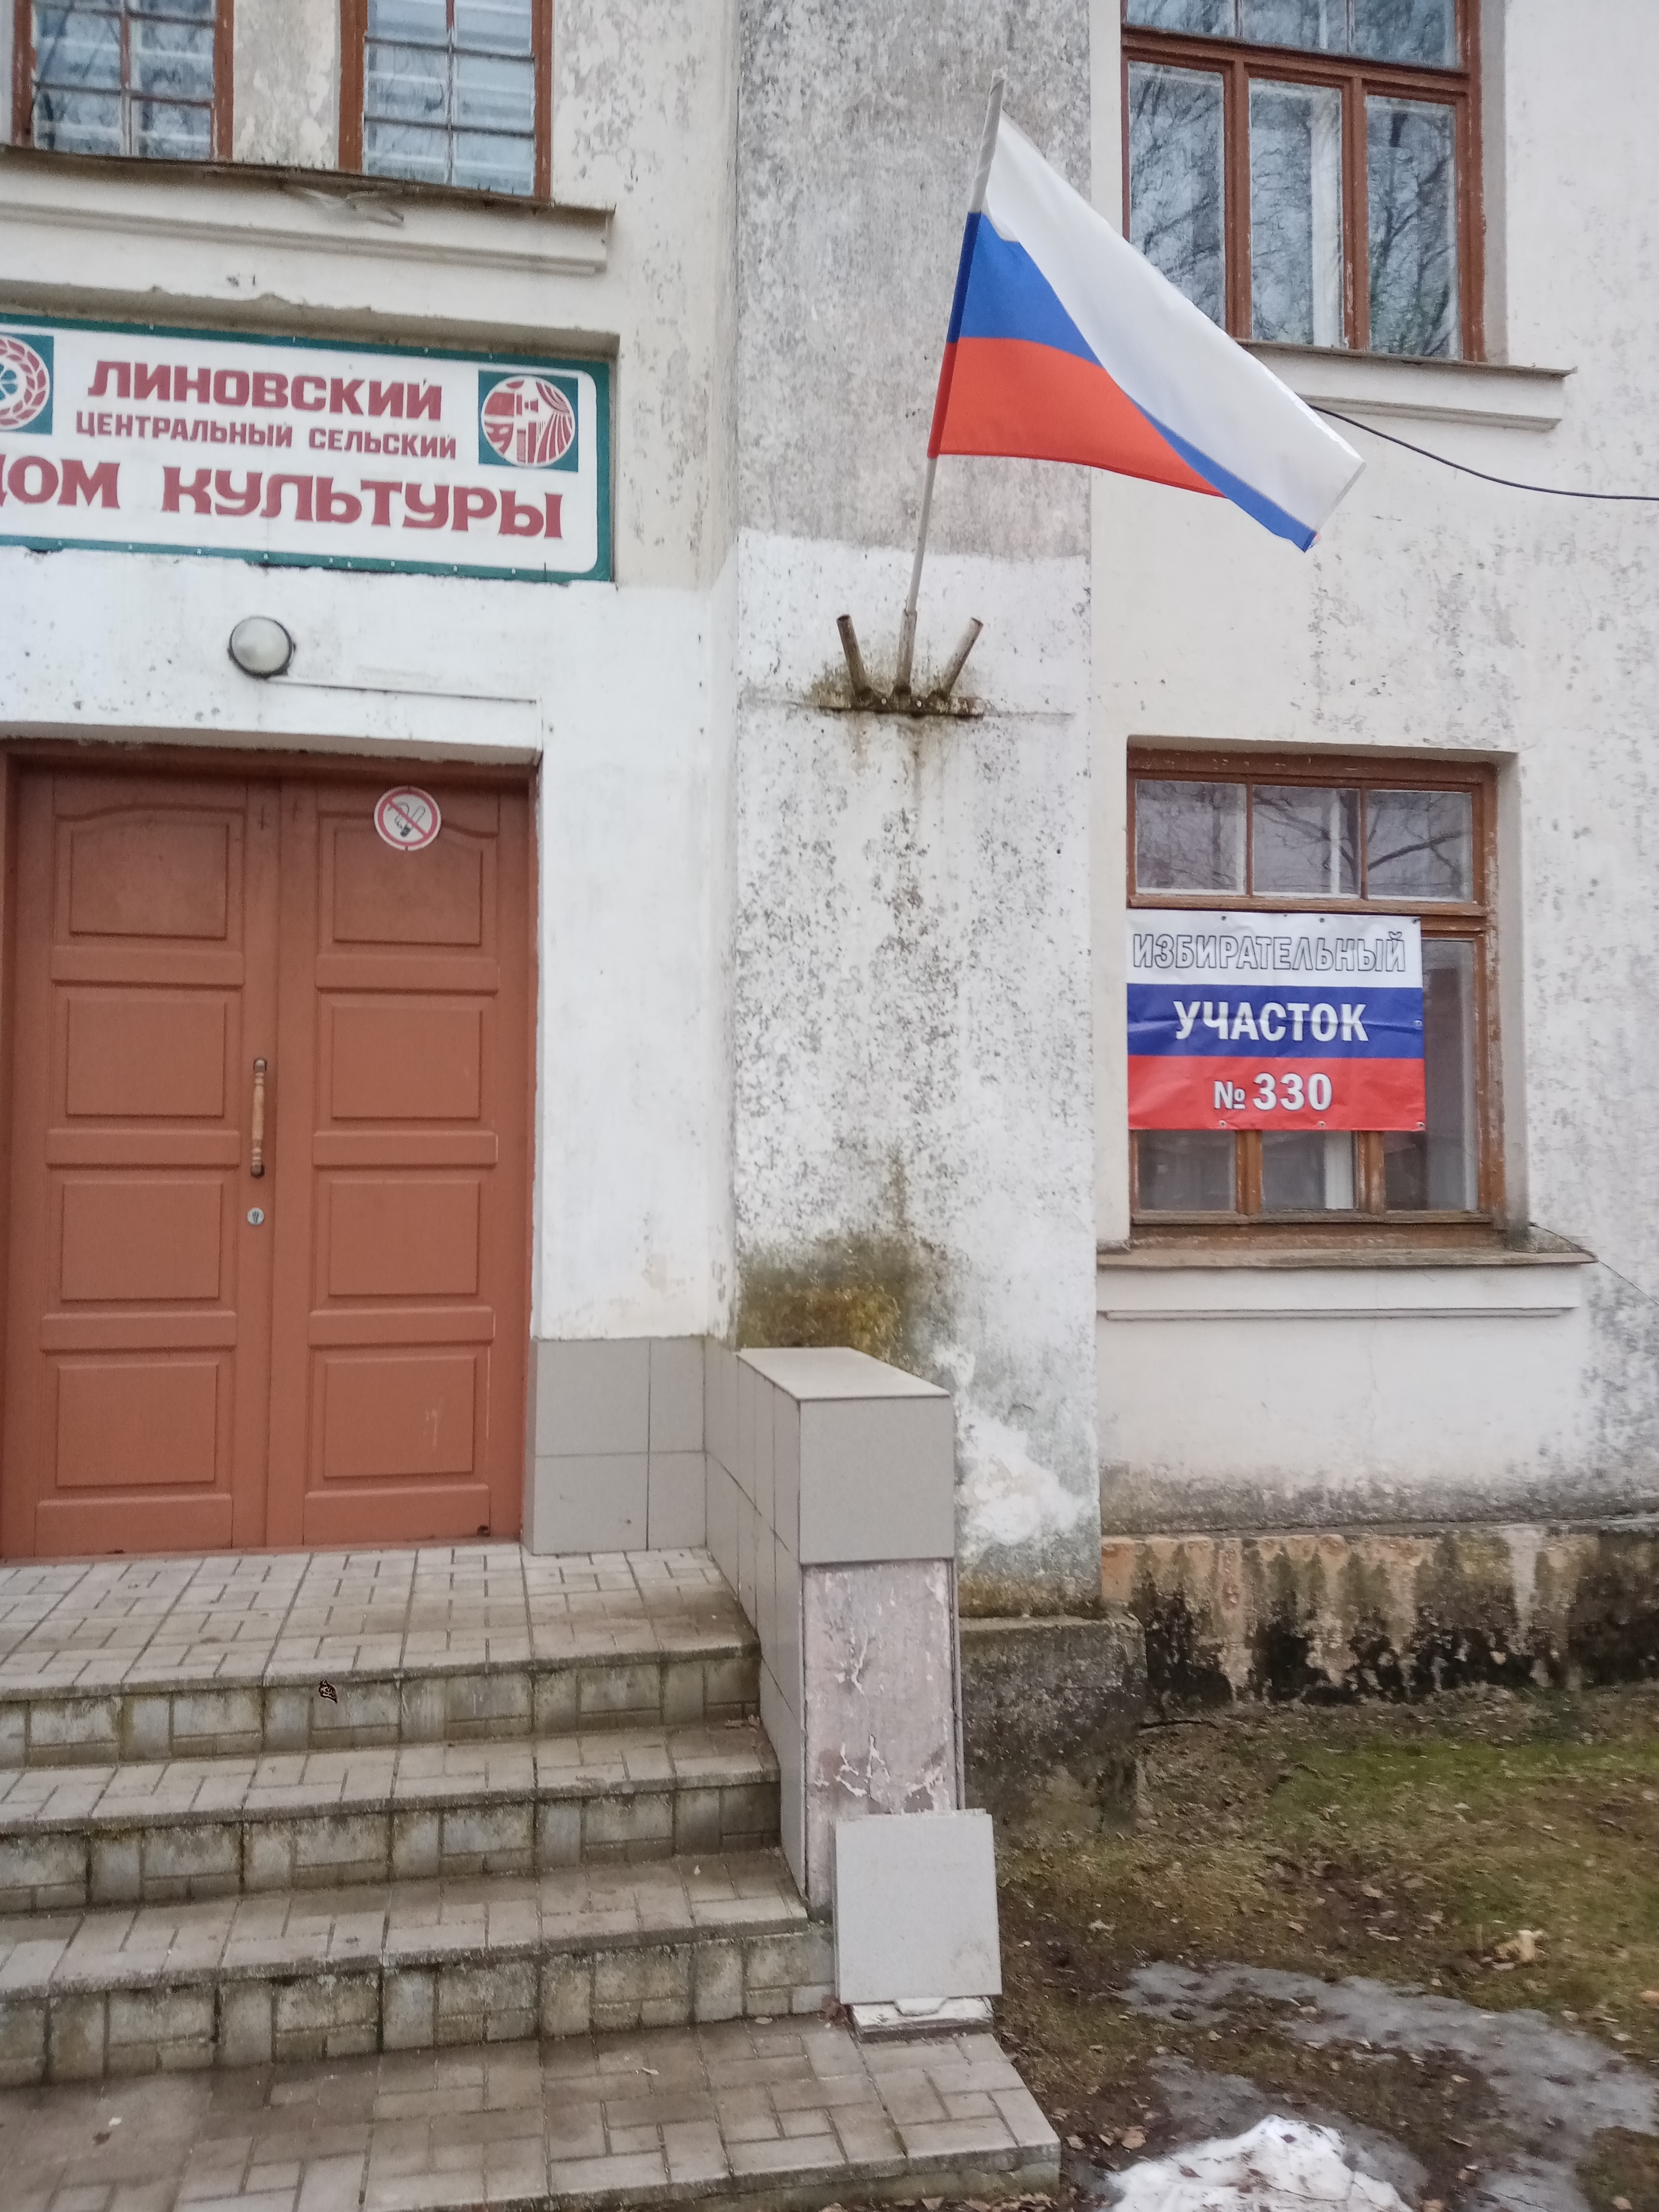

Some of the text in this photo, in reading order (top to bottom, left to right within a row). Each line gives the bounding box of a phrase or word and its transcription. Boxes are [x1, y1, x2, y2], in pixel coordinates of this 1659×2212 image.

[0, 454, 563, 540] ОМ КУЛЬТУРЫ
[1133, 931, 1406, 972] ИЗБИРАТЕЛЬНЫЙ
[1172, 1000, 1370, 1042] УЧАСТОК
